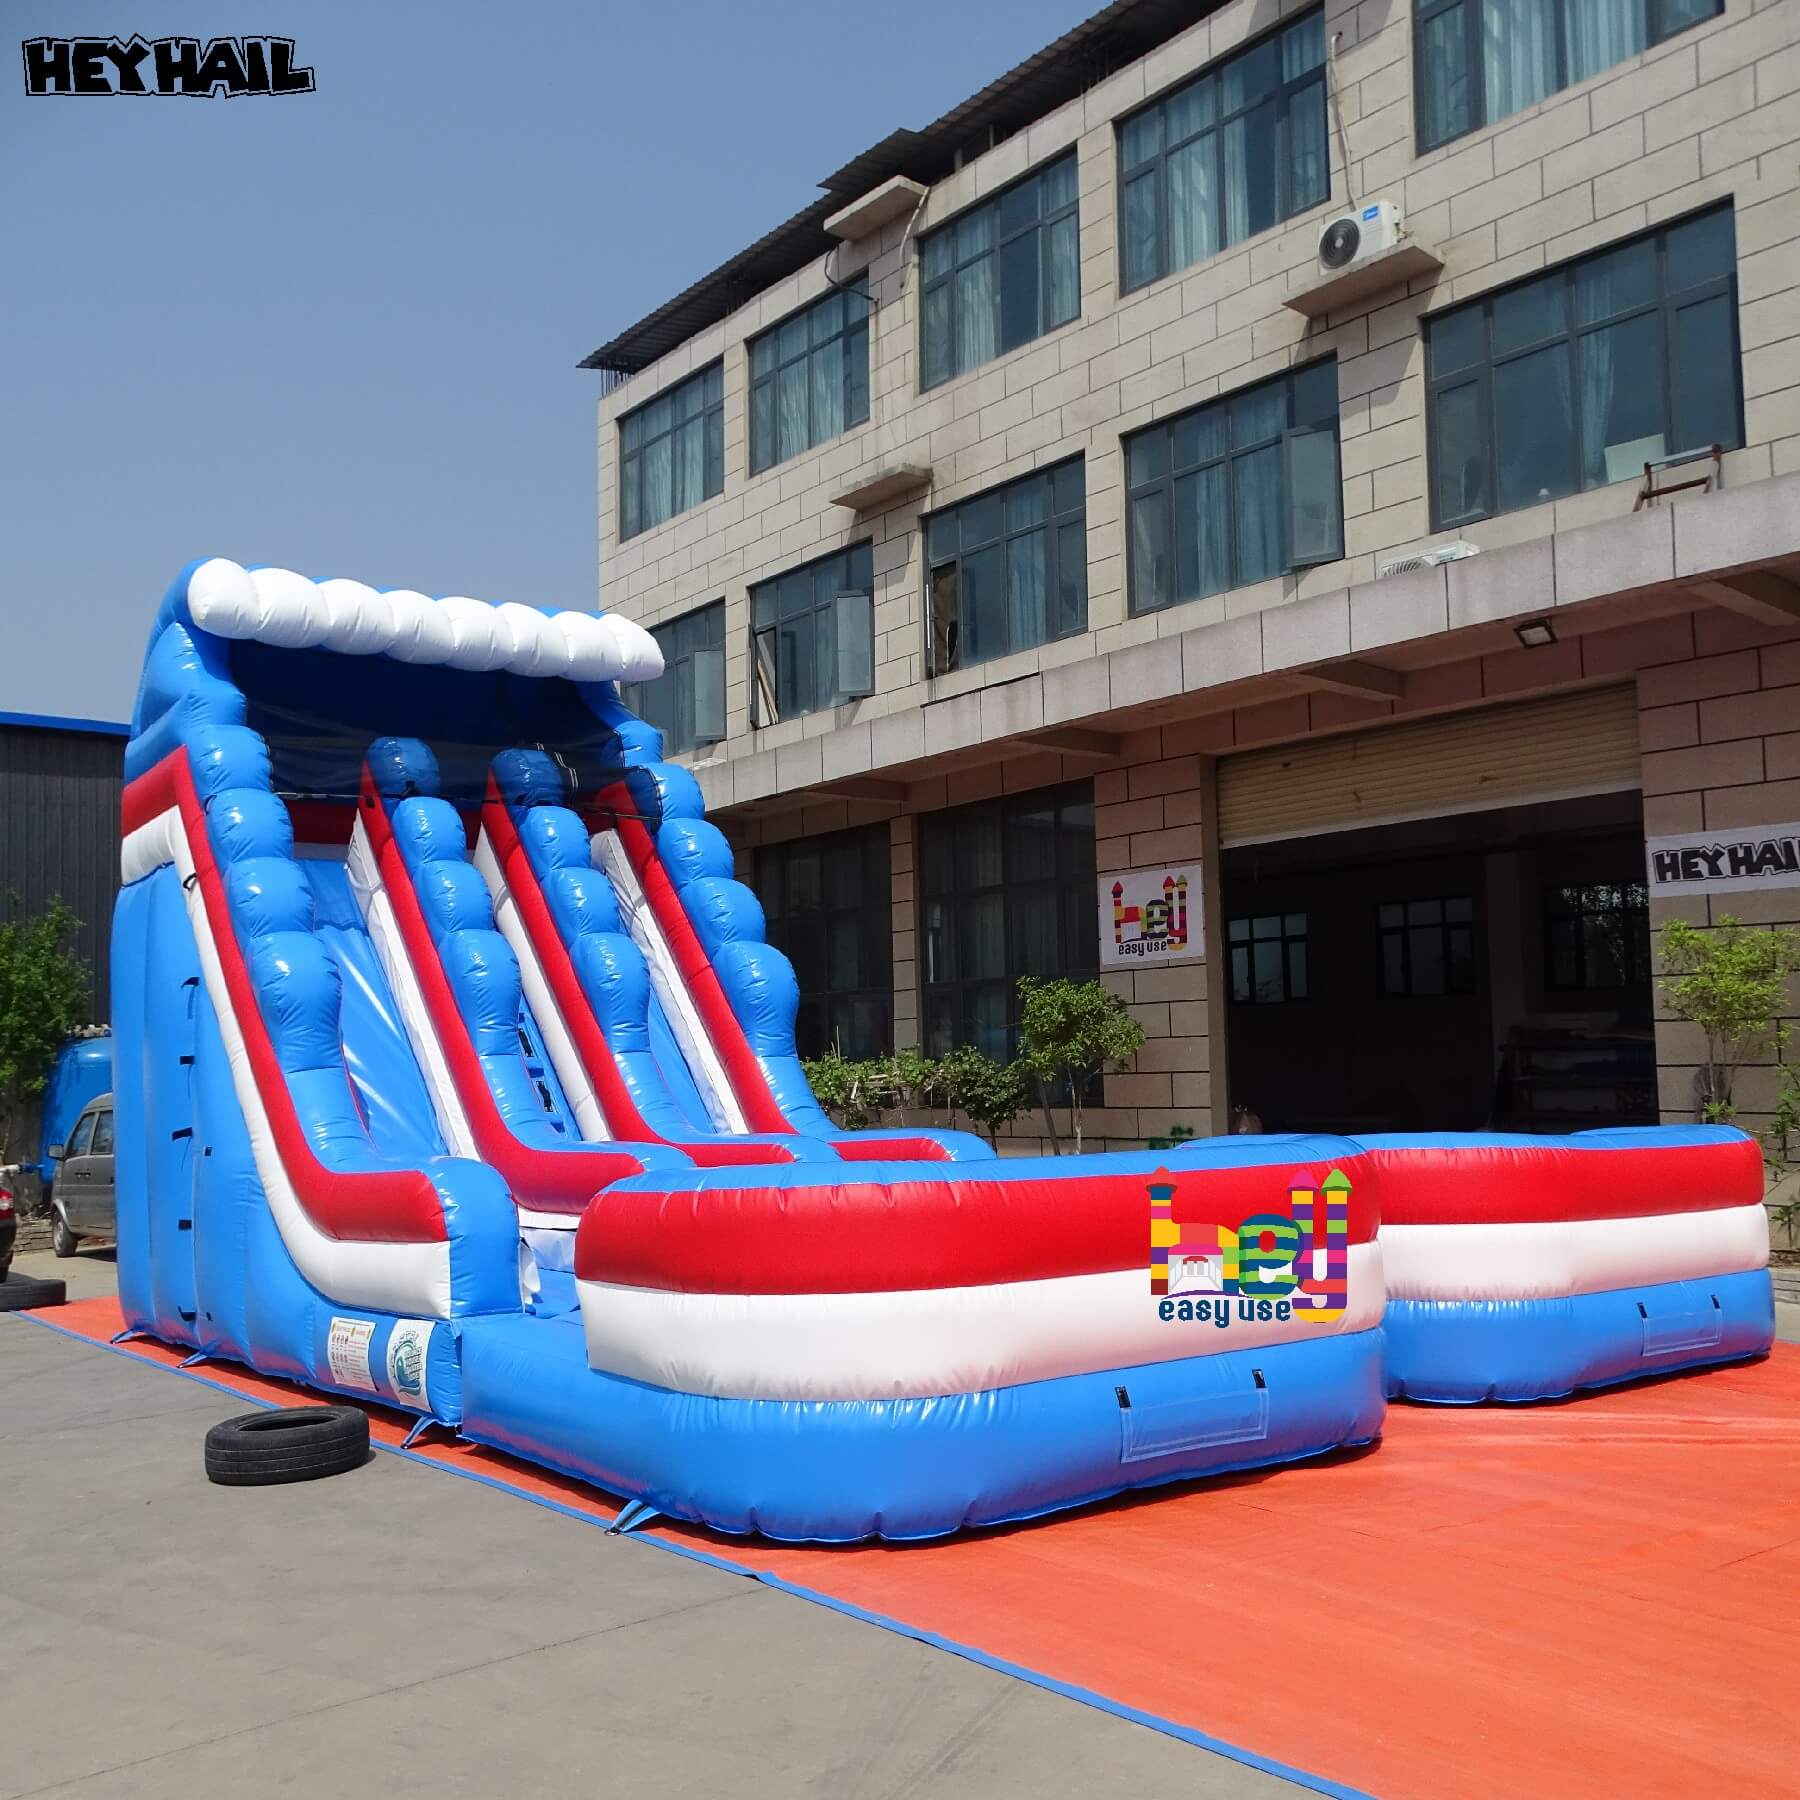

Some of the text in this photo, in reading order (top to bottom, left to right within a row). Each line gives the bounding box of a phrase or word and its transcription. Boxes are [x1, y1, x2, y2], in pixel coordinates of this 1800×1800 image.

[1653, 837, 1800, 883] HEYHAI
[1118, 940, 1167, 957] easy use
